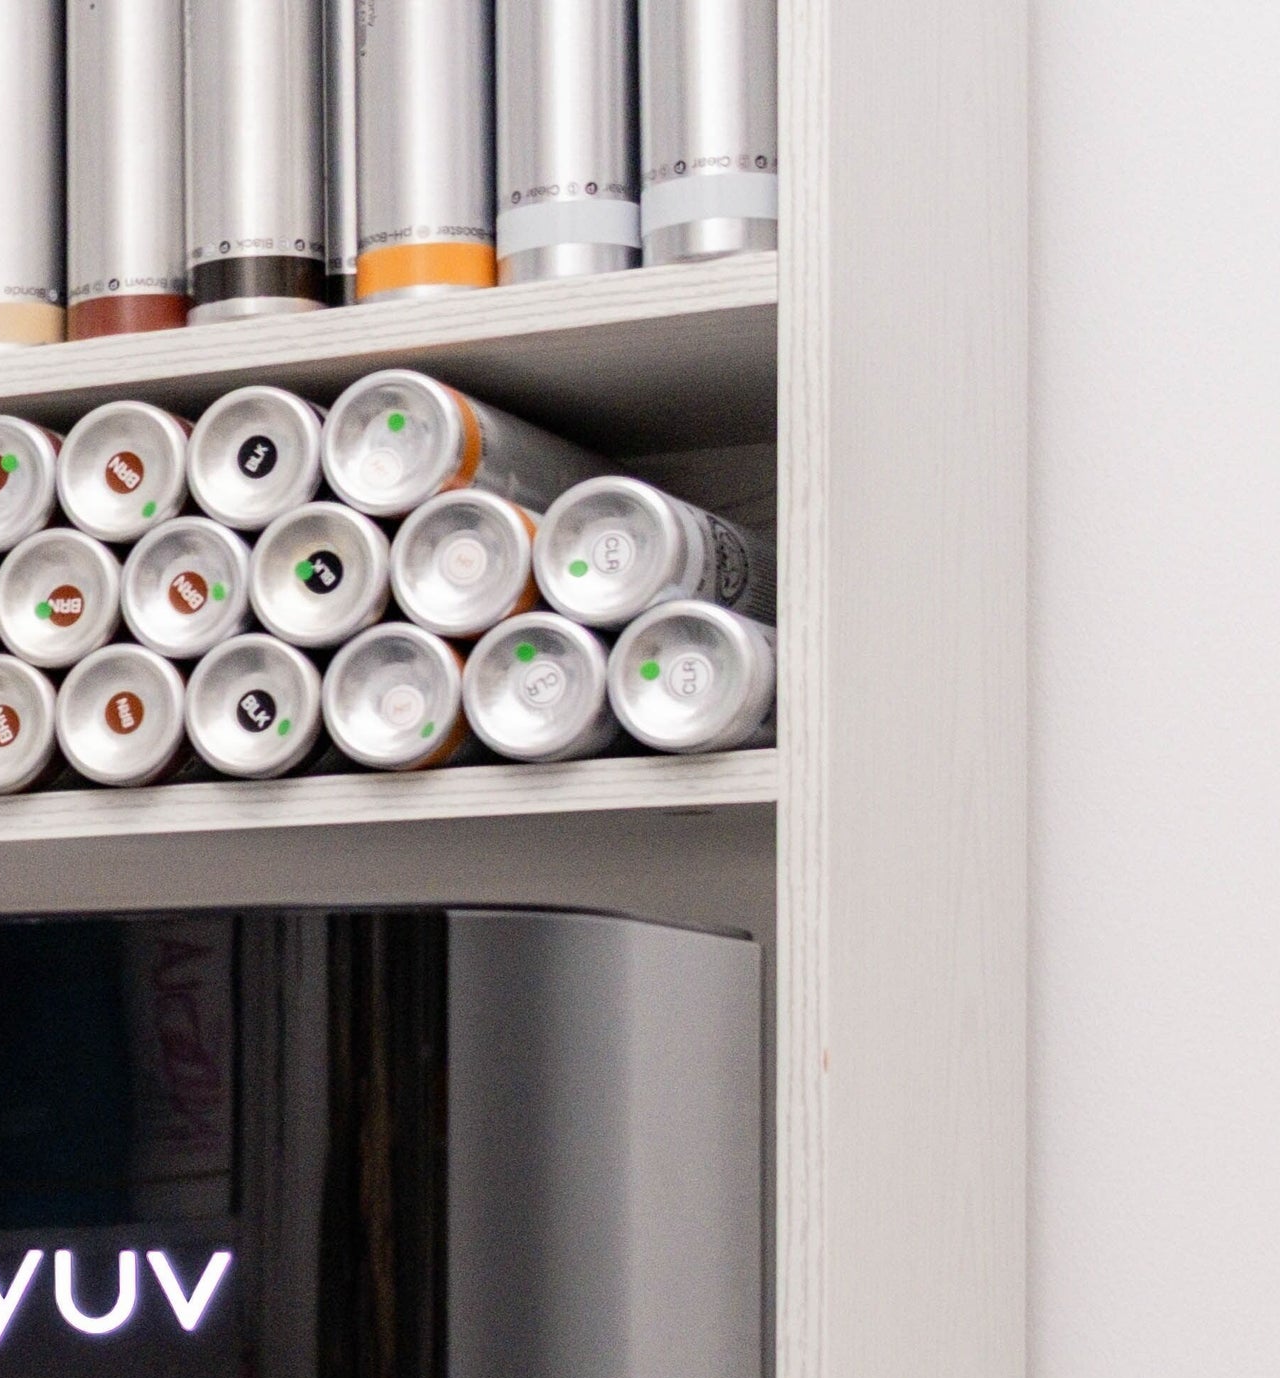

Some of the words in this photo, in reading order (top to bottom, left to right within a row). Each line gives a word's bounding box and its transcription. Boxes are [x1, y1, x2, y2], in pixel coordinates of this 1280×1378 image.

[692, 155, 731, 168] Clear
[236, 238, 274, 250] Black
[125, 277, 168, 289] Brown
[109, 456, 143, 489] BRN
[245, 443, 269, 472] BLK
[605, 536, 620, 571] CLR
[173, 575, 204, 610] BRN
[526, 674, 558, 697] CLR
[681, 660, 696, 694] CLR
[117, 697, 134, 728] BRN
[240, 694, 271, 728] BLK
